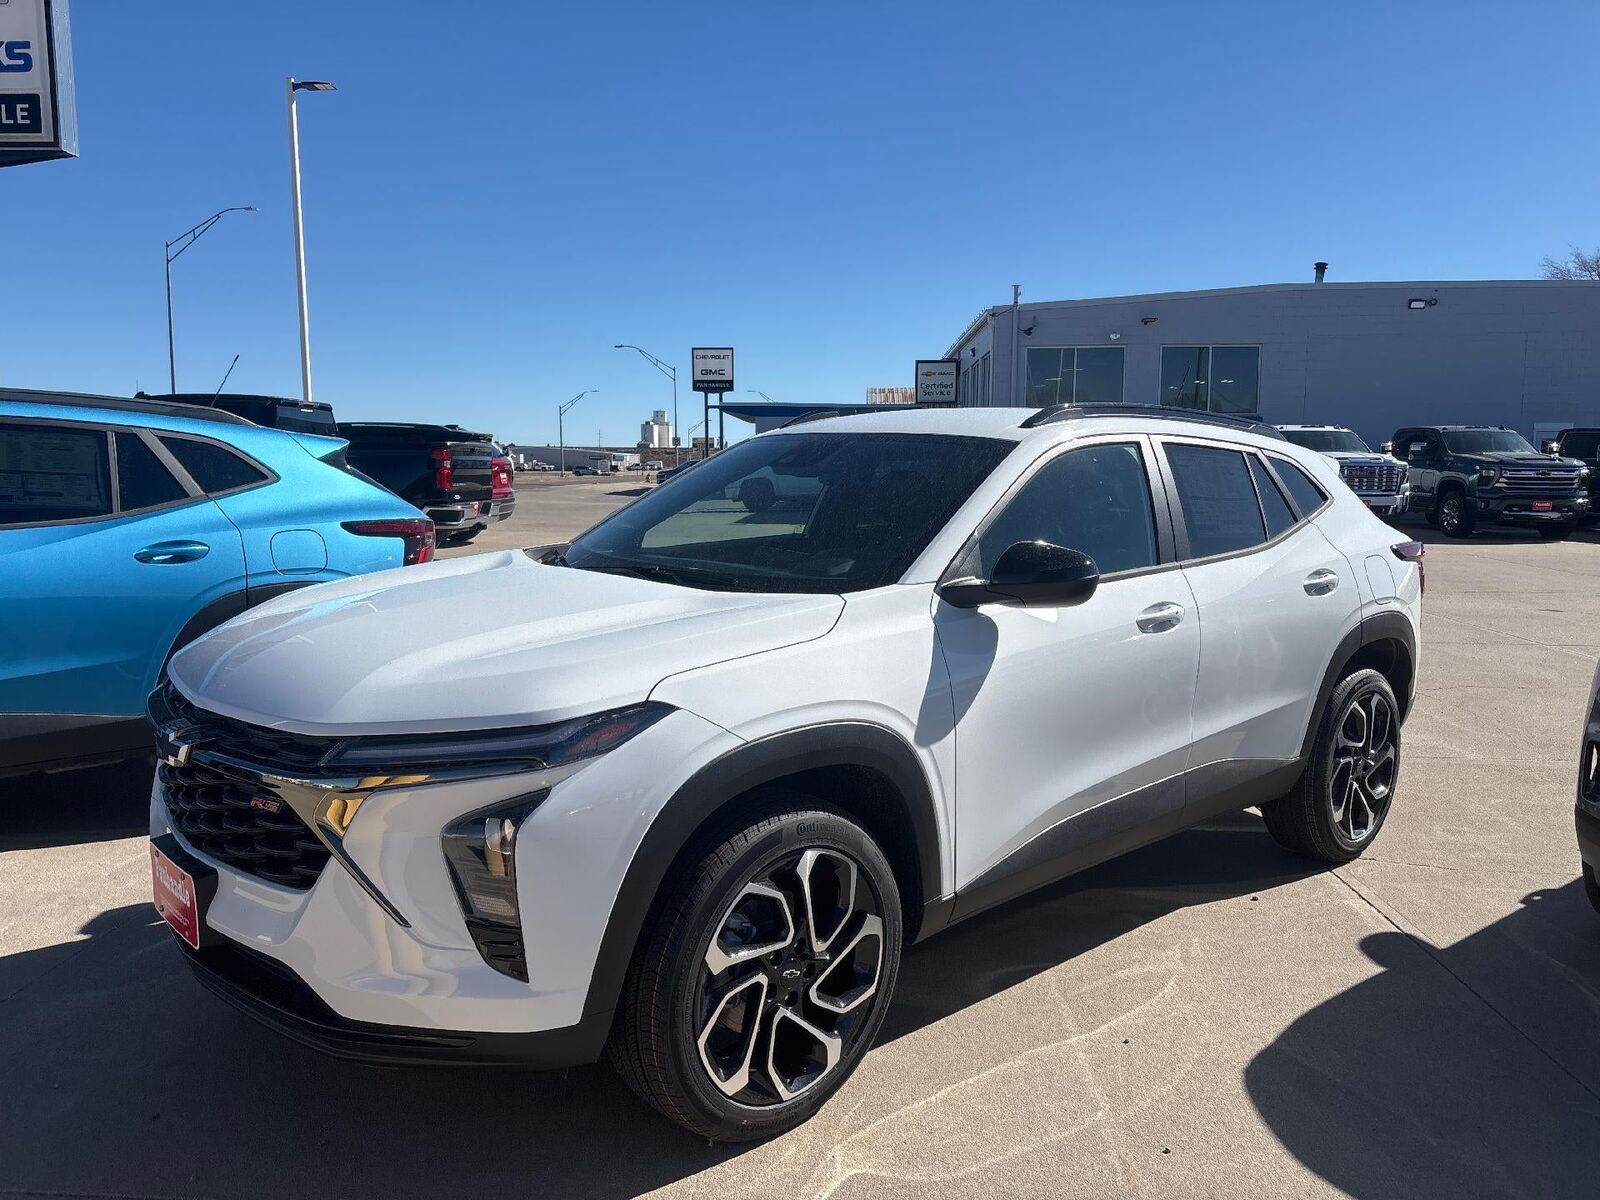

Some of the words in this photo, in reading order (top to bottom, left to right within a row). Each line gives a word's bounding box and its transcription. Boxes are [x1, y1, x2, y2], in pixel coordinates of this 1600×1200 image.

[0, 41, 32, 73] S
[700, 368, 726, 376] GMC
[920, 382, 953, 390] Certified
[922, 389, 951, 397] Service
[250, 798, 279, 813] RS
